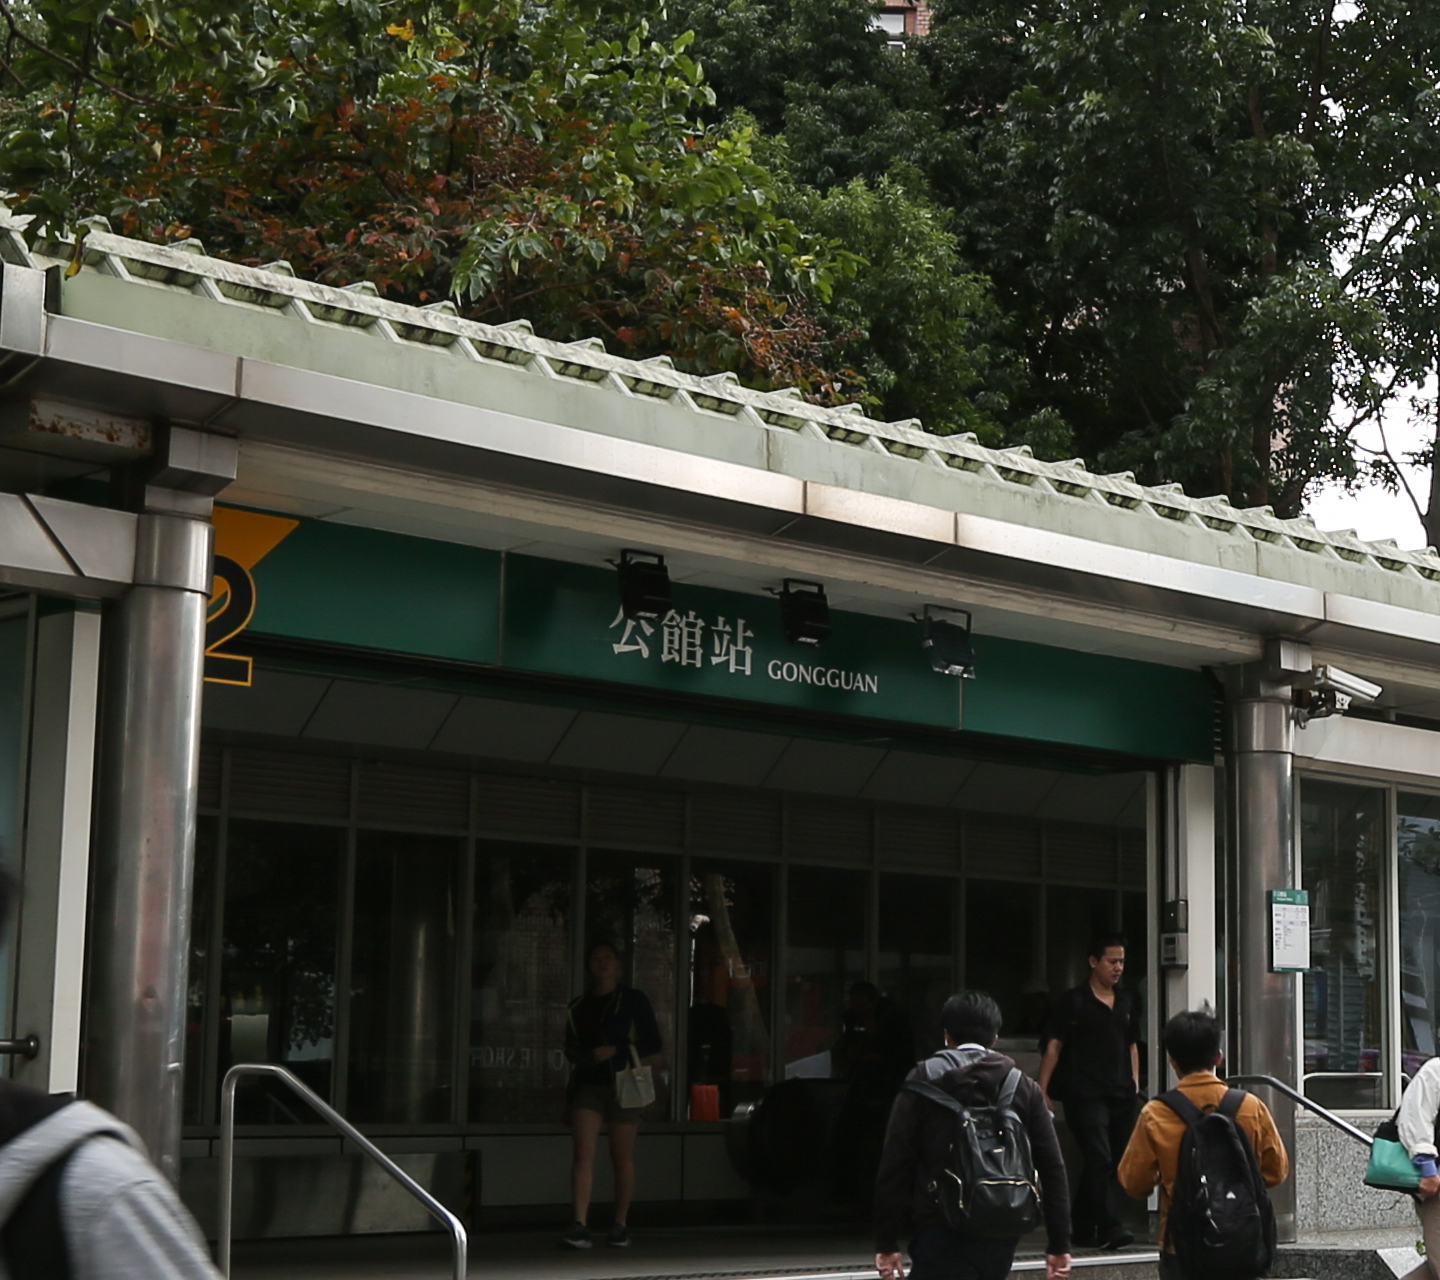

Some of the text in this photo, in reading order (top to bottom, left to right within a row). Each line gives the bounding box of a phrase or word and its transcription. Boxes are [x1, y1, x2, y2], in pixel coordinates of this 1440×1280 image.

[203, 554, 256, 687] 2
[609, 604, 755, 676] 公館站
[767, 659, 879, 694] GONGGUAN
